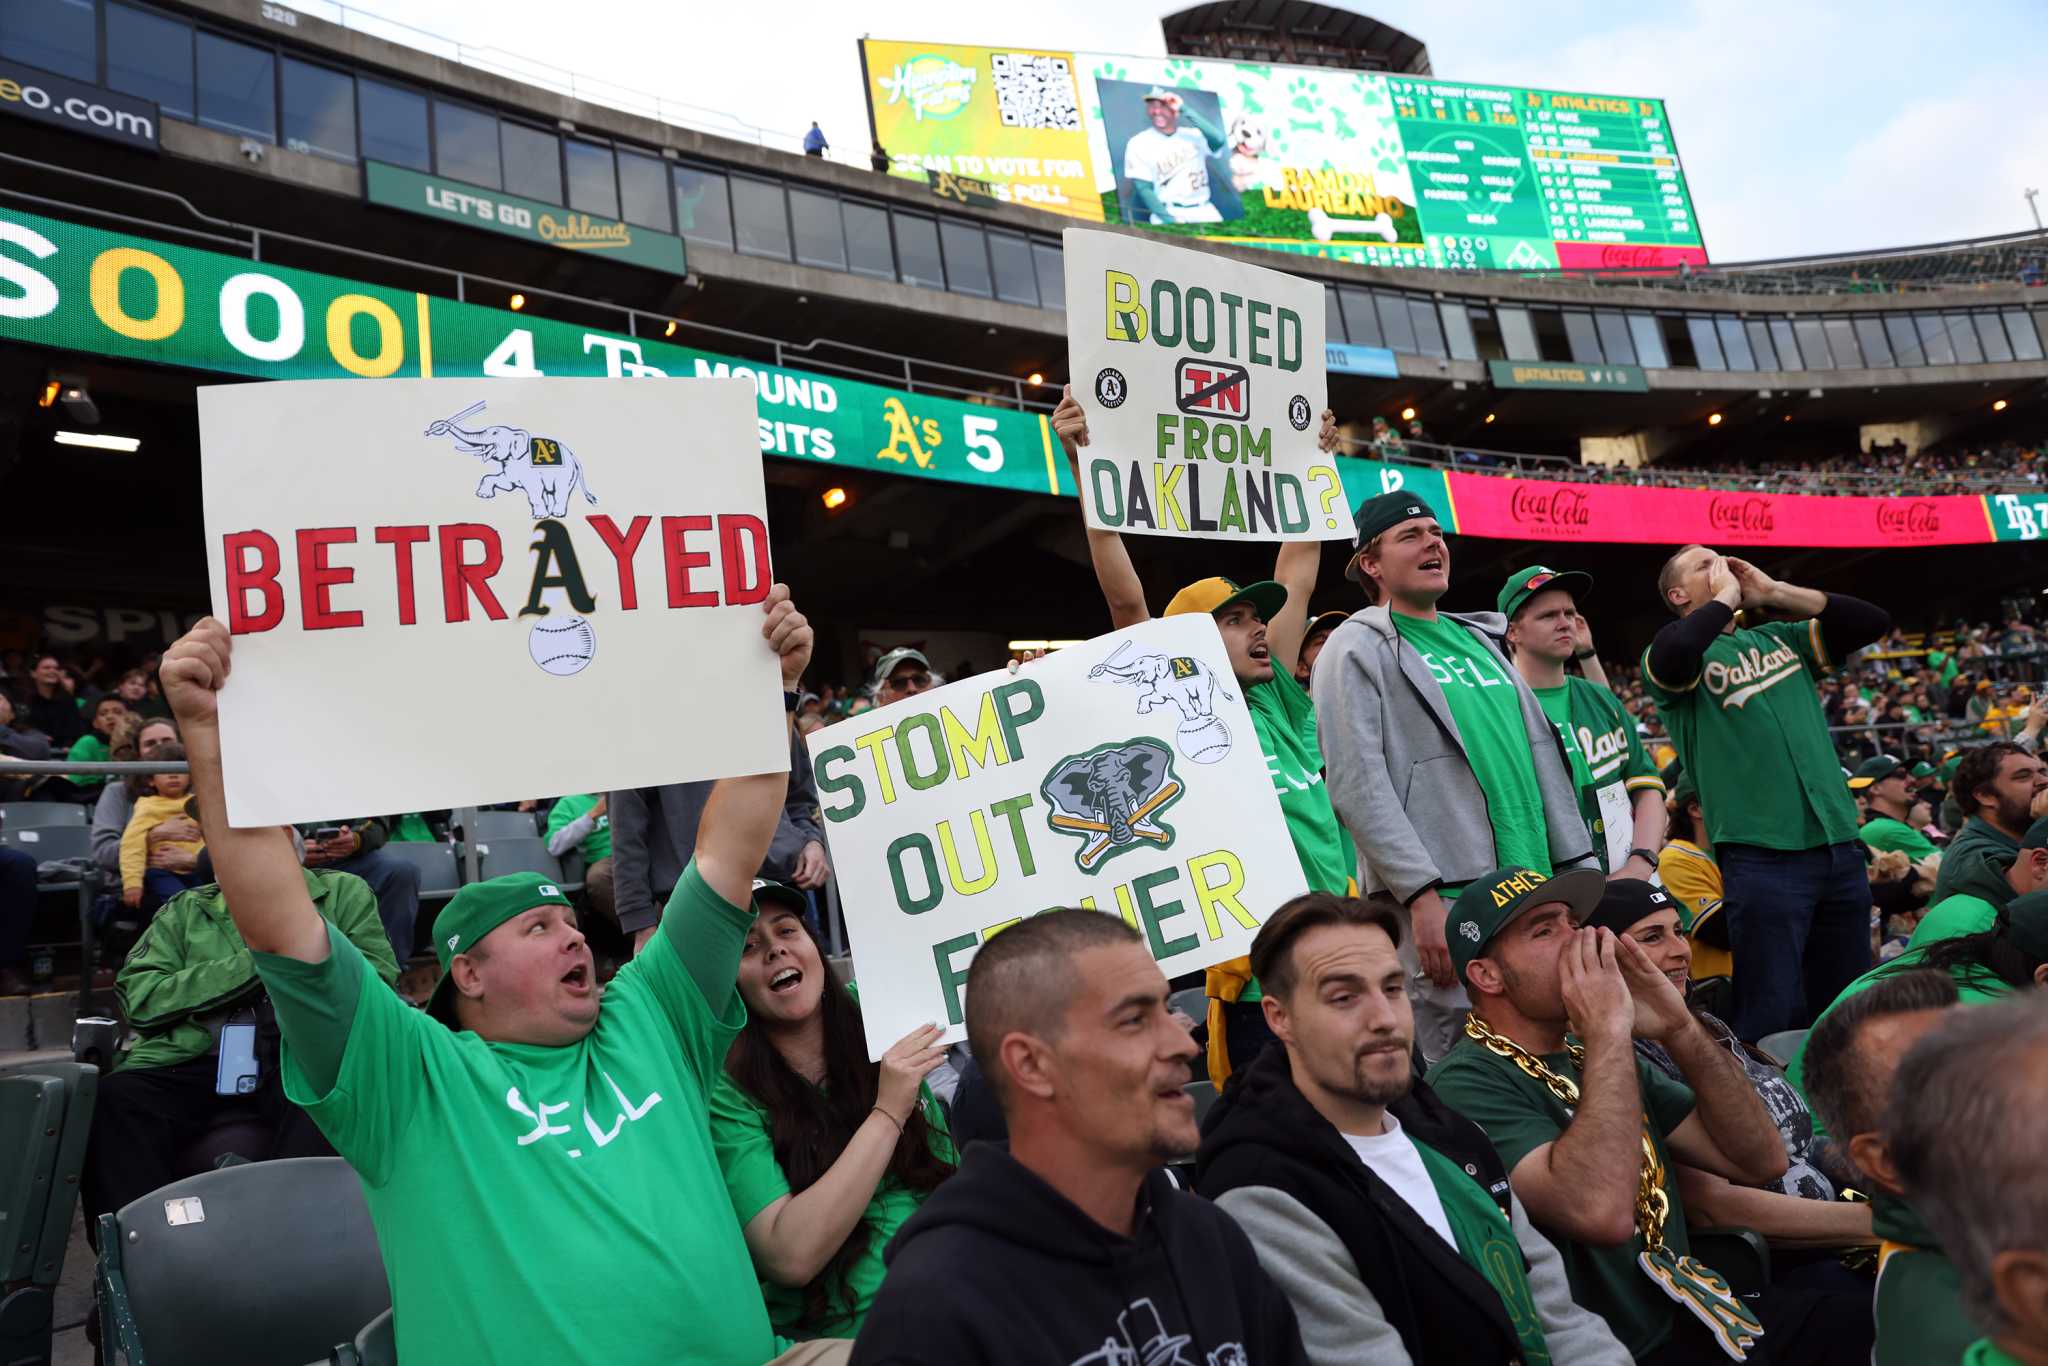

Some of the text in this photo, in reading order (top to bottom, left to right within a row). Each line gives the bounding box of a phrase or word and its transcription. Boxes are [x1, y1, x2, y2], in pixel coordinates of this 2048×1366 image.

[1551, 96, 1629, 113] ATHLETICS
[954, 155, 985, 174] TO
[985, 156, 1041, 176] VOTE
[1043, 159, 1086, 178] FOR
[1014, 184, 1069, 204] POLL
[425, 187, 631, 249] LET'S GO Oakland
[533, 437, 561, 466] A's
[877, 397, 943, 469] A's
[963, 414, 1004, 473] 5
[1157, 413, 1272, 467] FROM
[1090, 457, 1342, 534] OAKLAND?
[222, 513, 772, 635] BETRAYED
[1703, 635, 1800, 695] Oakland
[814, 678, 1045, 823] STOMP
[886, 793, 1037, 915] OUT
[506, 1071, 663, 1159] SELL
